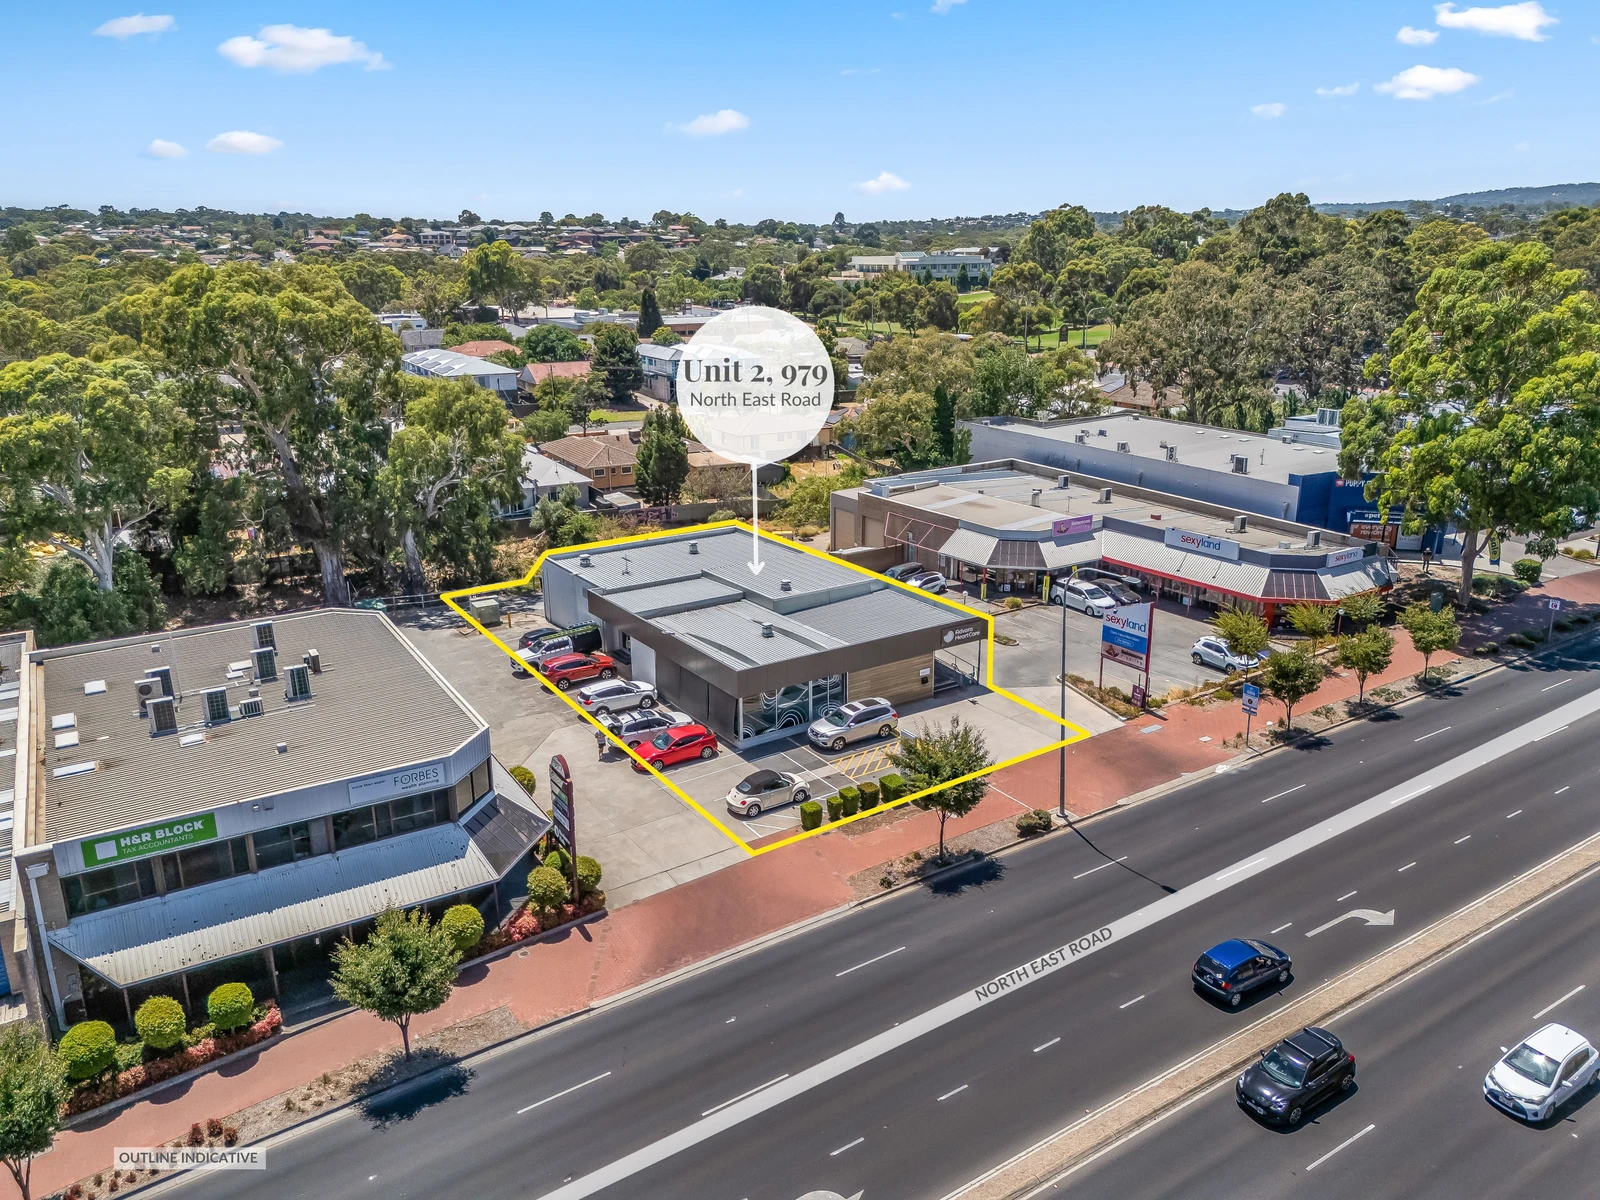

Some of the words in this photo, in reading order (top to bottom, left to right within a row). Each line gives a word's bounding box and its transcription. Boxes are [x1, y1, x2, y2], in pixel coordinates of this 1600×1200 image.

[1181, 535, 1221, 551] sexyland
[1335, 550, 1359, 562] sexyland
[1105, 613, 1147, 632] sexyland
[394, 768, 438, 786] FORBES
[119, 832, 152, 848] H&R
[155, 820, 204, 838] BLOCK
[138, 833, 193, 849] ACCOUNTANTS
